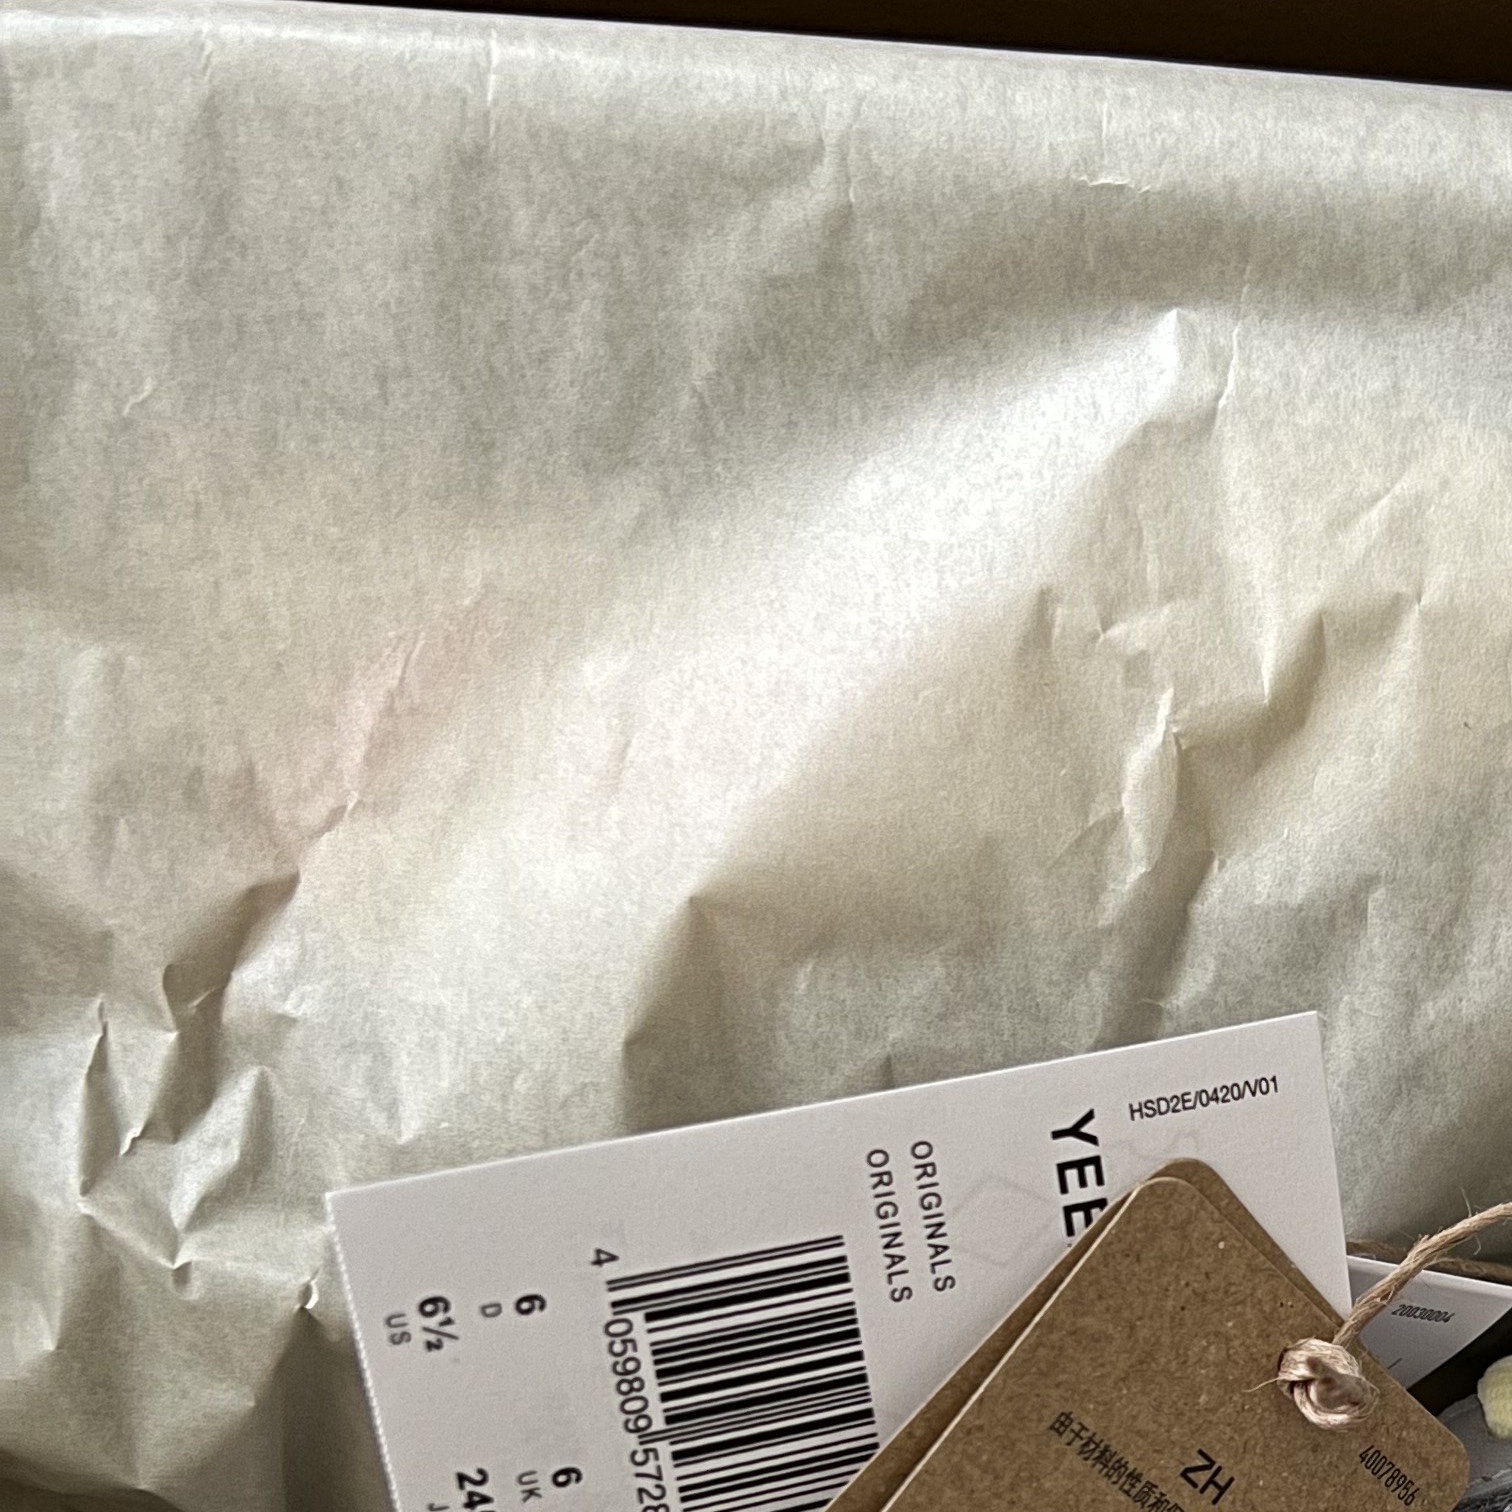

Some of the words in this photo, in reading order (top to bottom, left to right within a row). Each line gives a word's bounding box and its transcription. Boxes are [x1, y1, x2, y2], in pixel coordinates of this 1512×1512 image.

[1128, 1075, 1279, 1122] HSD2E/0420/V01
[866, 1148, 914, 1303] ORIGINALS
[910, 1140, 956, 1293] ORIGINALS
[590, 1248, 620, 1268] 4
[478, 1301, 503, 1319] D
[513, 1293, 548, 1317] 6
[384, 1312, 412, 1347] US
[602, 1318, 653, 1434] 059809
[515, 1469, 543, 1504] UK
[550, 1466, 583, 1489] 6
[1179, 1448, 1235, 1506] ZH
[1358, 1444, 1418, 1507] 40078956
[426, 1502, 448, 1512] J
